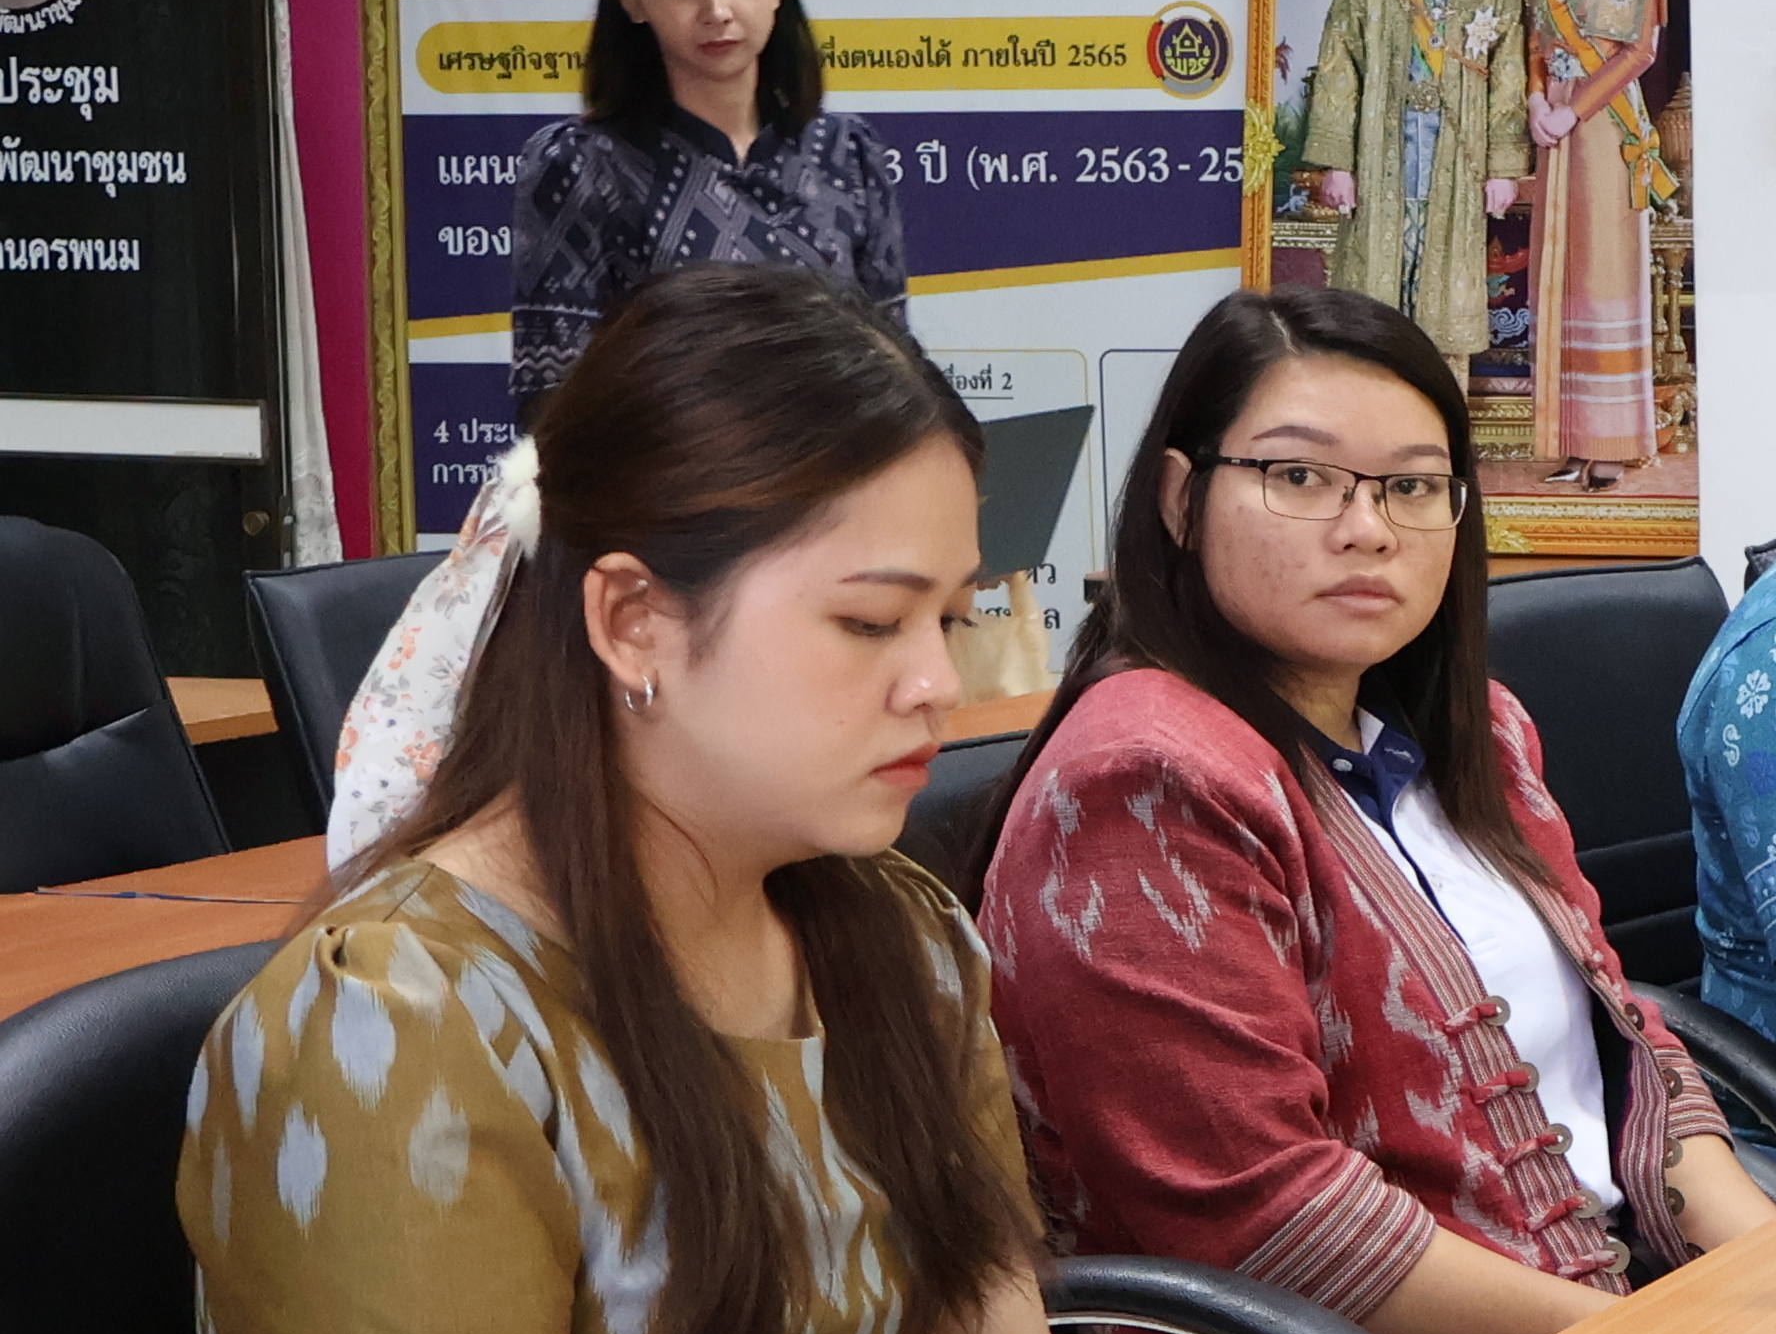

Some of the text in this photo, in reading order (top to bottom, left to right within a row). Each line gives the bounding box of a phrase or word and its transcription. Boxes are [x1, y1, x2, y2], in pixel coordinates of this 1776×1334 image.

[962, 34, 1056, 68] ภายในปี
[1067, 43, 1128, 68] 2565
[438, 154, 522, 186] แผน
[915, 137, 948, 184] ปี
[965, 144, 1059, 191] (พ.ศ.
[0, 237, 140, 270] นครพนม
[438, 224, 512, 256] ของ
[1001, 372, 1013, 390] 2
[433, 420, 450, 444] 4
